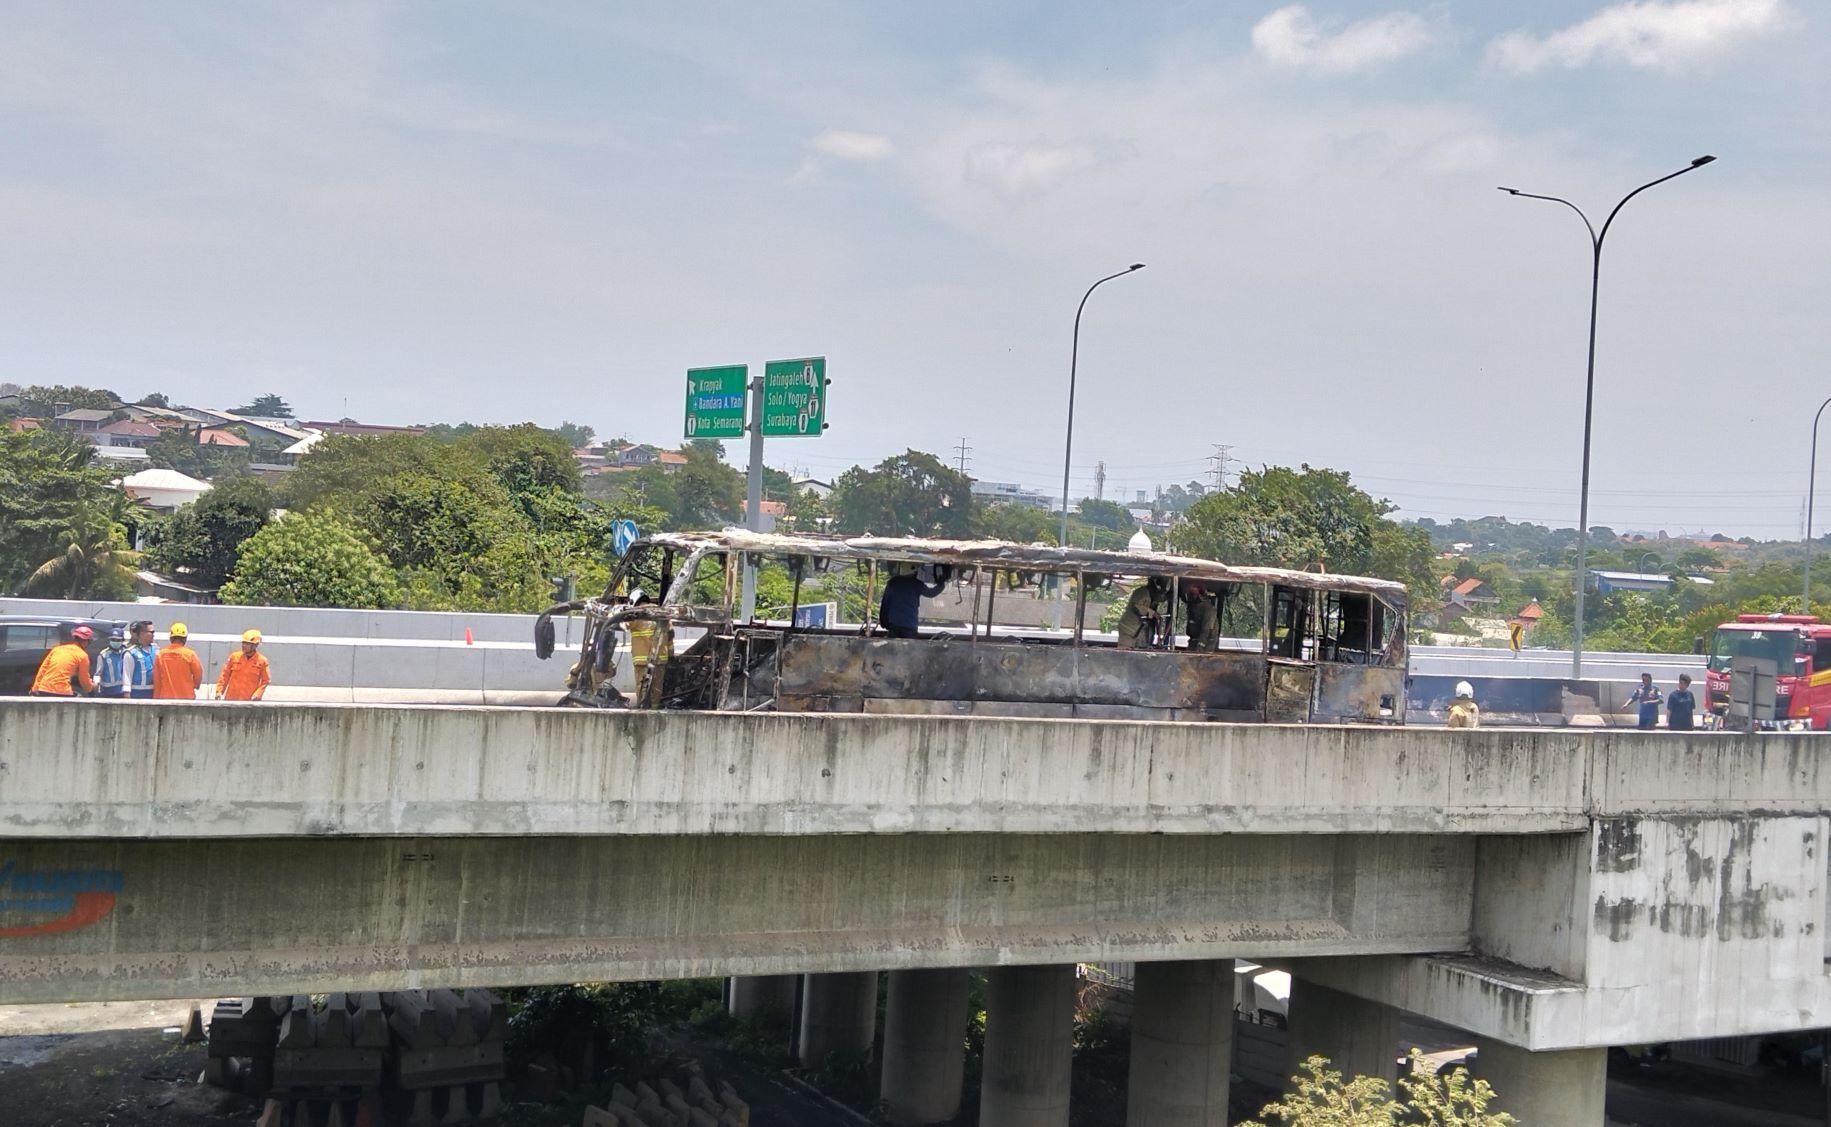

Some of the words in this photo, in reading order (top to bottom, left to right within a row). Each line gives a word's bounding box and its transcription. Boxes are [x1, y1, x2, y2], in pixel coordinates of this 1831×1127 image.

[700, 378, 722, 394] Krapyak
[769, 372, 804, 389] Jatingaleh
[699, 397, 722, 410] Bandara
[724, 396, 730, 409] A.
[698, 417, 710, 429] Kota
[713, 417, 743, 432] Semarang
[766, 412, 797, 430] Surabaya
